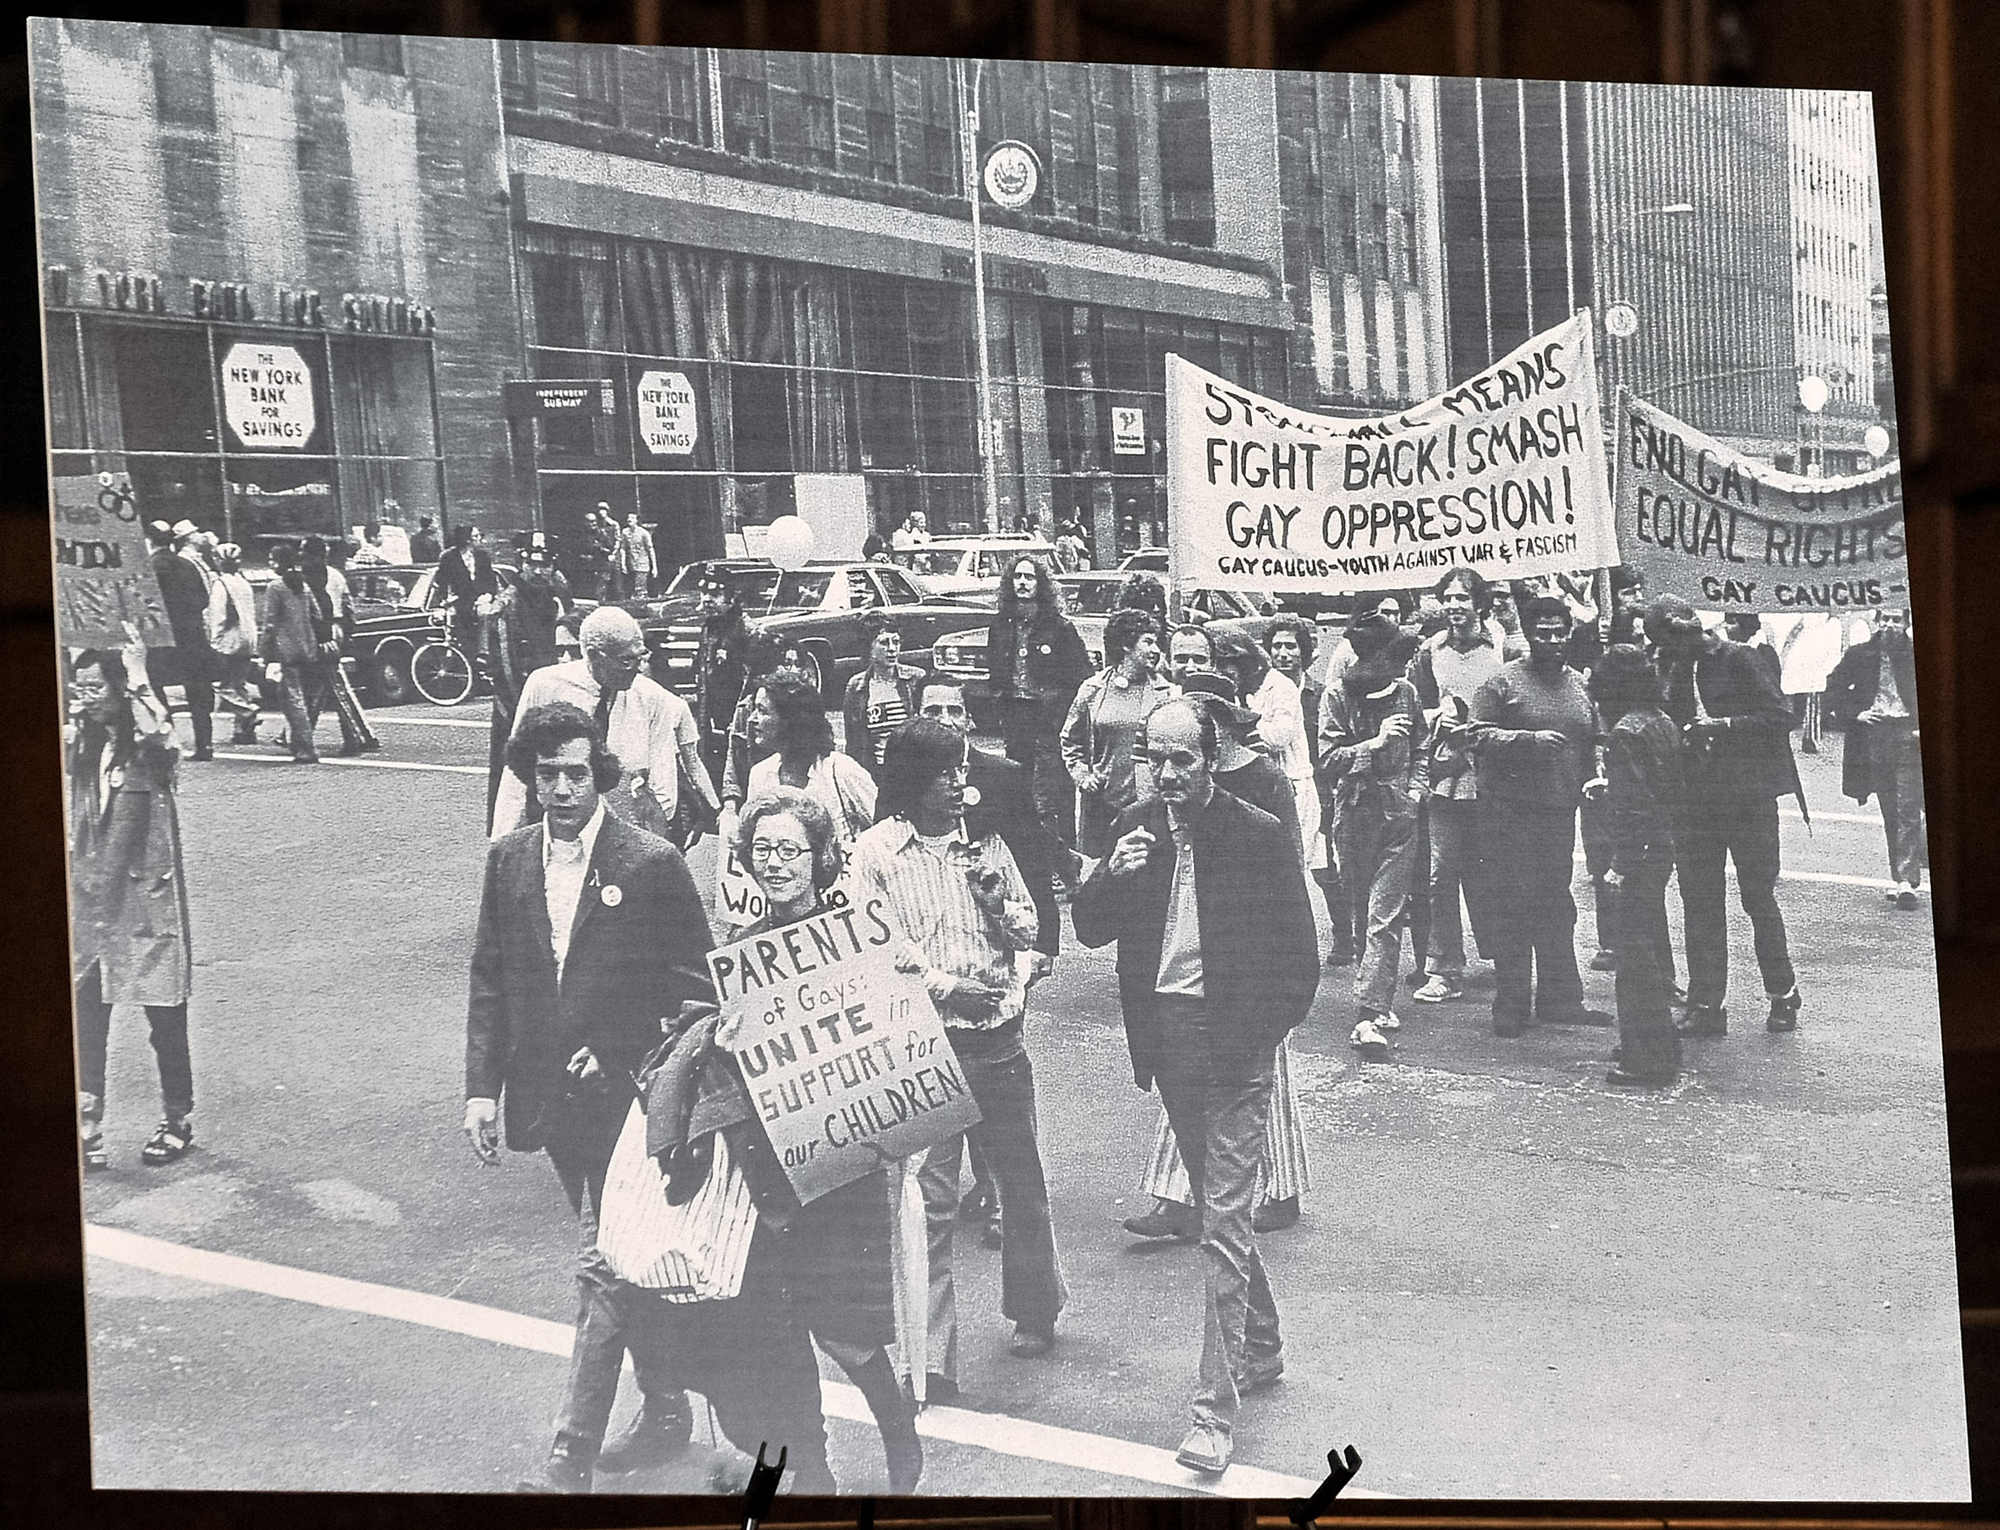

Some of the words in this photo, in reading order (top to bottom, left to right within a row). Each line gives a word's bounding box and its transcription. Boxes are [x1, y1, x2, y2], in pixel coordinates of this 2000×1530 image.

[257, 353, 274, 365] THE
[230, 367, 259, 384] NEW
[265, 369, 303, 386] YORK
[660, 378, 672, 389] THE
[1442, 342, 1567, 417] MEANS
[250, 386, 287, 405] BANK
[543, 397, 582, 408] SUBWAY
[642, 390, 662, 404] NEW
[665, 391, 690, 405] YORK
[261, 406, 280, 419] FOR
[655, 405, 680, 419] BANK
[662, 421, 676, 431] FOR
[242, 420, 303, 438] SAVINGS
[650, 433, 691, 447] SAVINGS
[1206, 437, 1322, 492] FIGHT
[1466, 402, 1584, 476] SMASH
[1630, 413, 1685, 481] END
[1225, 500, 1302, 550] GAY
[1322, 465, 1575, 551] OPPRESSION!
[1637, 486, 1746, 564] EQUAL
[1217, 556, 1259, 576] GAY
[1393, 546, 1457, 572] AGAINST
[1461, 542, 1495, 564] WAR
[1516, 532, 1577, 559] FASCISM
[1701, 576, 1756, 603] GAY
[1774, 579, 1883, 607] CAUCUS
[712, 899, 891, 1001] PARENTS
[763, 996, 786, 1026] of
[738, 1002, 873, 1079] UNITE
[889, 994, 910, 1022] in
[758, 1036, 896, 1123] SUPPORT
[904, 1030, 938, 1063] for
[783, 1139, 820, 1167] our
[824, 1058, 966, 1149] CHILDREN
